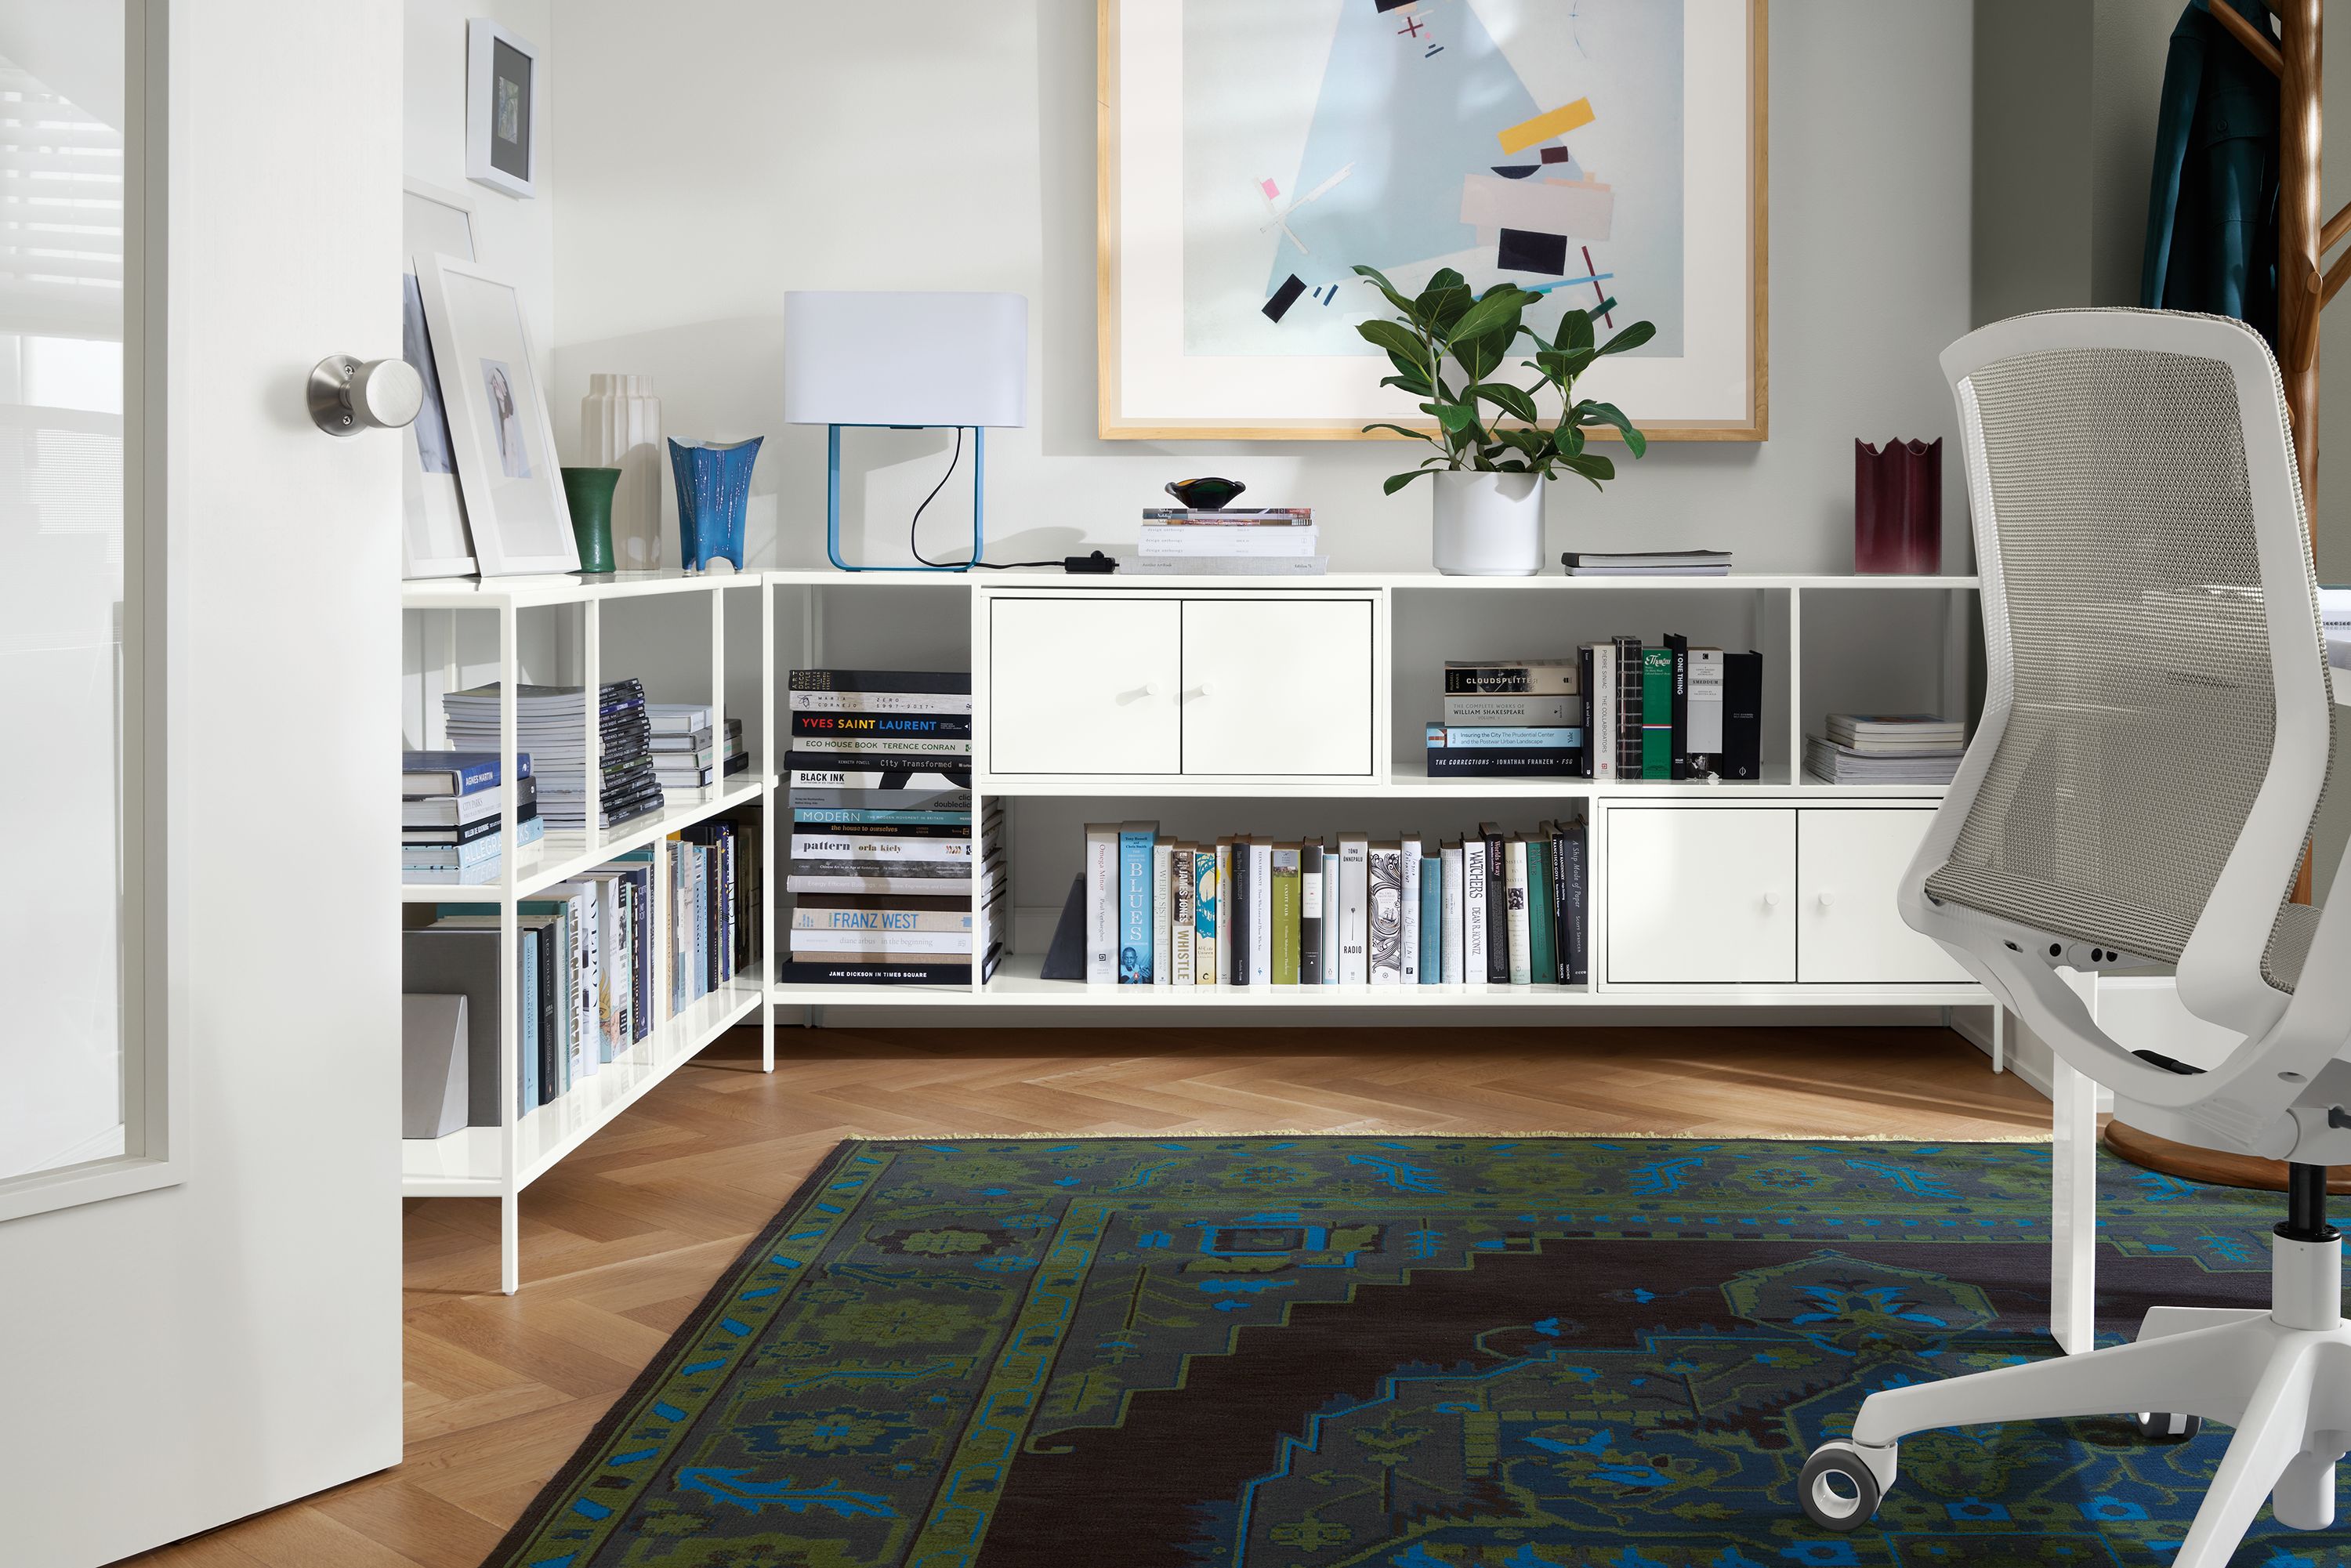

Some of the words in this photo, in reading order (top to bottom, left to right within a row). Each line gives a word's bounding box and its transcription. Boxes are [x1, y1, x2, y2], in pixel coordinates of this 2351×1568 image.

[802, 719, 833, 728] YVES
[838, 719, 875, 729] SAINT
[879, 721, 936, 730] LAURENT
[465, 774, 478, 786] AGNES
[478, 771, 493, 783] MARTIN
[801, 773, 827, 781] BLACK
[471, 799, 483, 809] PARKS
[803, 812, 860, 822] MODERN
[464, 834, 502, 862] ALLEGRA
[804, 842, 850, 852] pattern
[880, 845, 901, 853] kiely
[1469, 850, 1483, 899] WATCHERS
[1179, 871, 1188, 896] JAMES
[1128, 863, 1143, 940] BLUES
[1179, 899, 1188, 922] JONES
[834, 913, 878, 928] FRANZ
[882, 913, 918, 929] WEST
[900, 938, 933, 947] beginning
[1472, 931, 1480, 955] KOONTZ
[1178, 930, 1189, 980] WHISTLE
